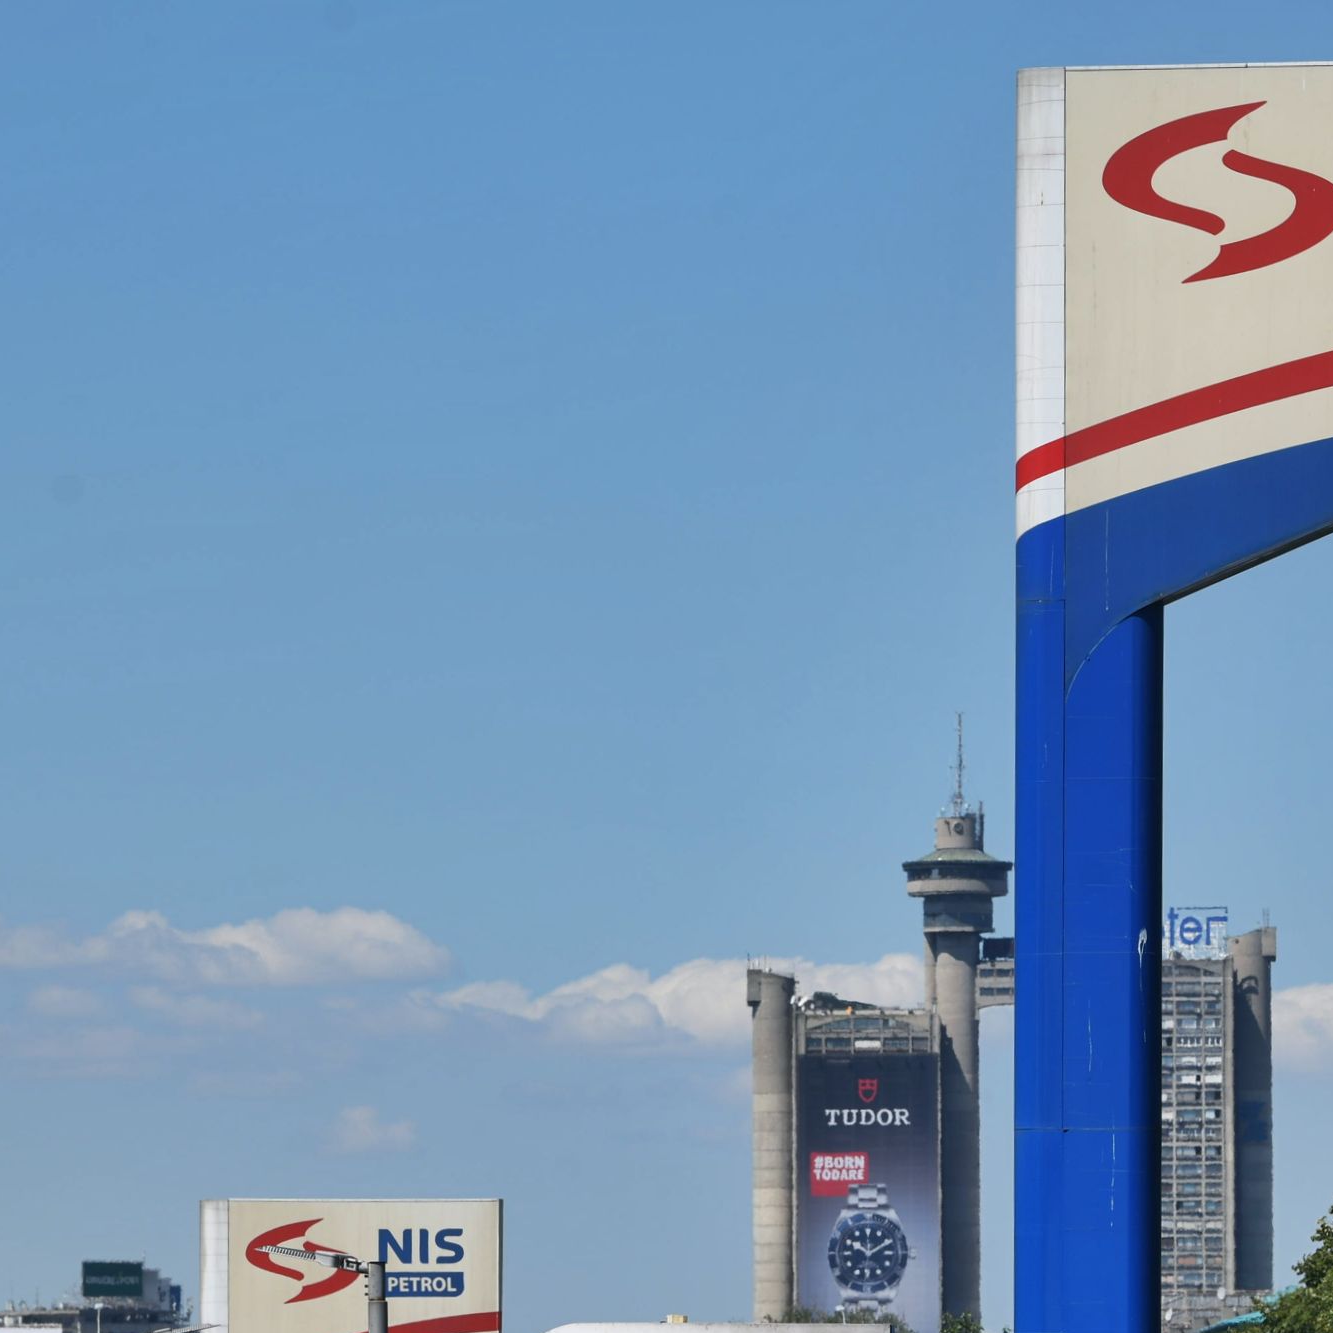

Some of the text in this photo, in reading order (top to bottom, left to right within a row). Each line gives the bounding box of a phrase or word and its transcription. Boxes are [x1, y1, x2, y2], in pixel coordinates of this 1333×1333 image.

[1167, 907, 1228, 947] ter
[825, 1109, 911, 1126] TUDOR
[814, 1155, 865, 1169] #BORN
[378, 1228, 465, 1264] NIS
[387, 1277, 457, 1292] PETROL
